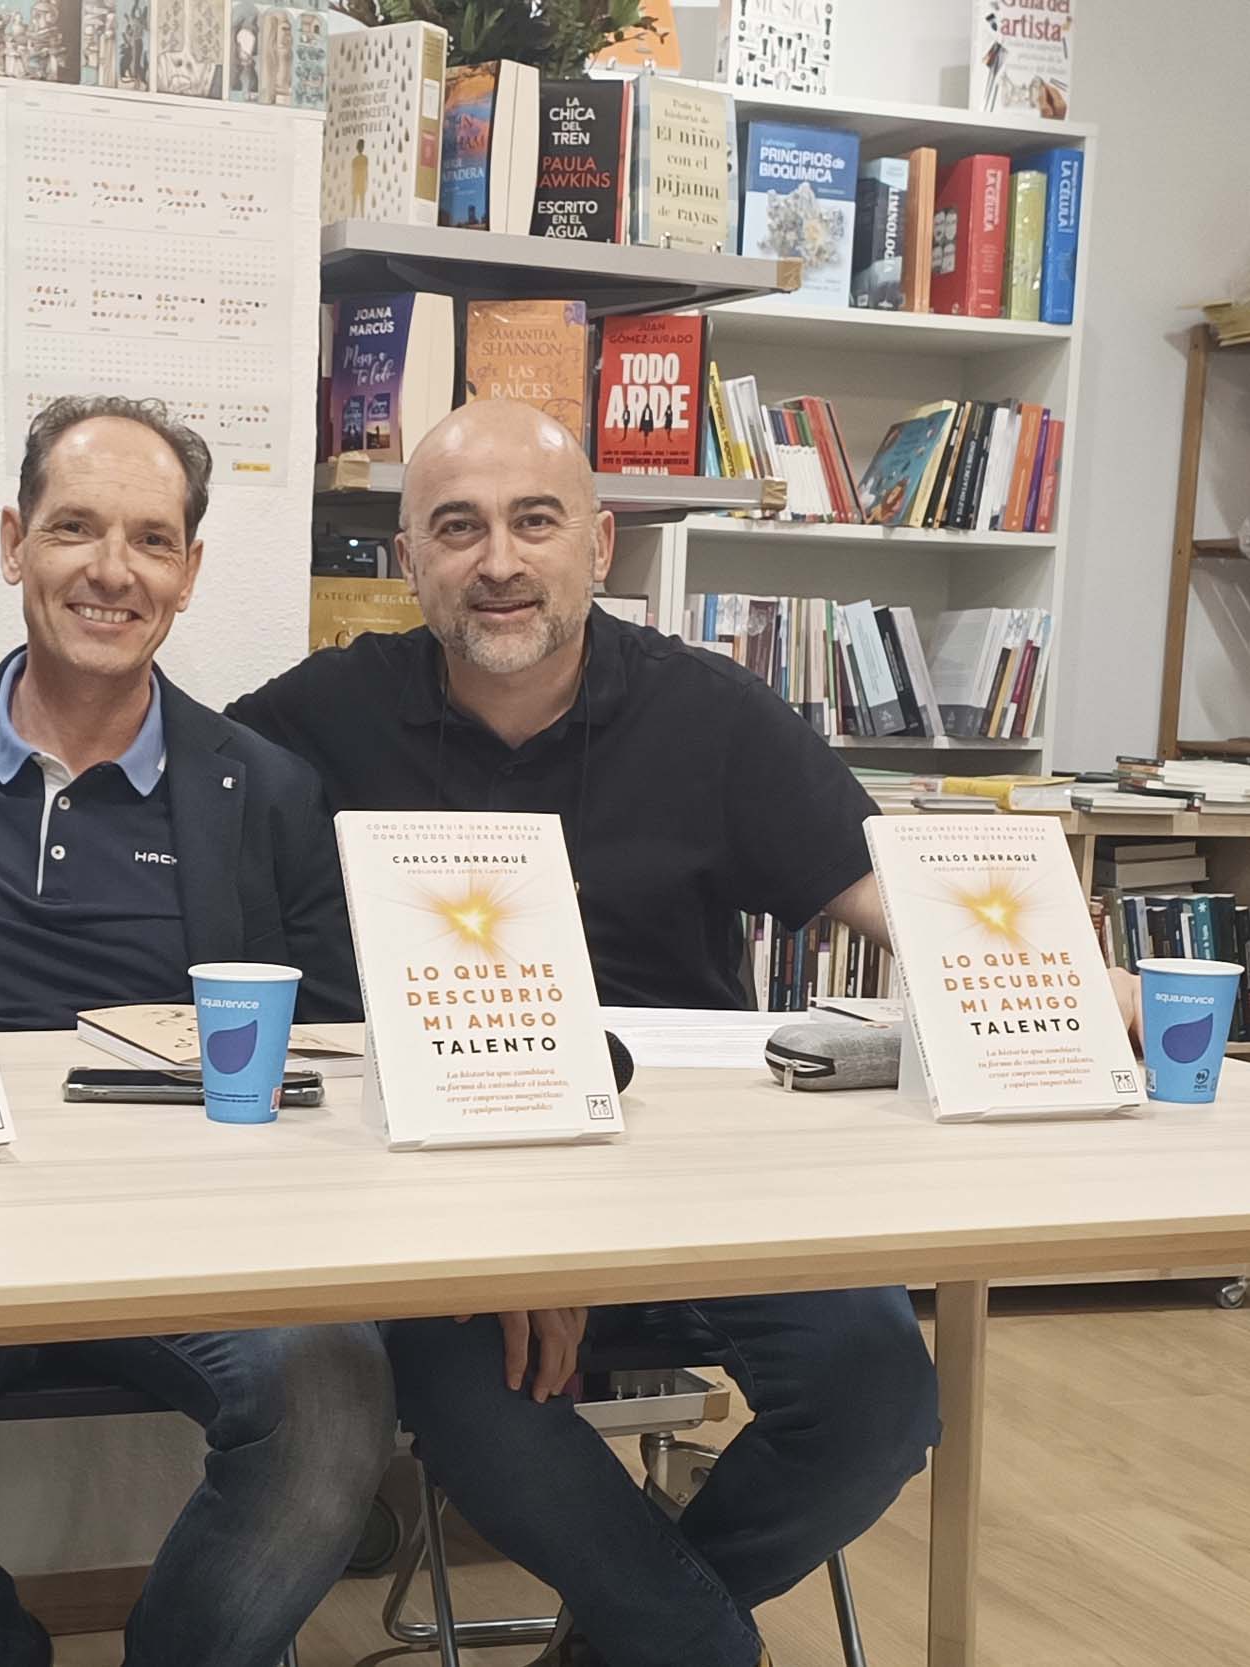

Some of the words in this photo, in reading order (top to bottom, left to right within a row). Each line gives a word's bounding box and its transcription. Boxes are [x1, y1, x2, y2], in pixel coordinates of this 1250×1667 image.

[1001, 14, 1062, 42] artista
[566, 97, 580, 107] LA
[549, 108, 595, 121] CHICA
[561, 121, 582, 131] DEL
[552, 132, 590, 145] TREN
[656, 125, 675, 142] El
[679, 127, 720, 150] niño
[542, 155, 597, 171] PAULA
[667, 155, 691, 167] con
[695, 156, 708, 170] el
[760, 146, 832, 169] PRINCIPIOS
[832, 158, 846, 170] de
[759, 162, 833, 184] BIOQUÍMICA
[1060, 161, 1072, 177] LA
[539, 172, 611, 189] AWKINS
[656, 174, 720, 200] pijama
[537, 200, 598, 214] ESCRITO
[1058, 179, 1071, 228] CÉLULA
[552, 215, 568, 225] EN
[569, 215, 582, 225] EL
[658, 204, 671, 217] de
[677, 209, 719, 227] rayas
[545, 225, 588, 239] AGUA
[354, 306, 392, 321] JOANA
[350, 319, 394, 336] MARCÚS
[487, 328, 557, 340] SAMANTHA
[638, 322, 666, 332] JUAN
[481, 342, 563, 357] SHANNON
[508, 364, 535, 379] LAS
[620, 353, 680, 385] TODO
[490, 379, 552, 399] RAÍCES
[604, 385, 691, 430] ARDE
[316, 591, 367, 602] ESTUCHE
[392, 855, 448, 864] CARLOS
[454, 853, 528, 864] BARRAQUÉ
[919, 854, 968, 862] CARLOS
[974, 853, 1038, 862] BARRAQUÉ
[942, 954, 971, 968] LO
[984, 953, 1030, 967] QUE
[1041, 952, 1072, 966] ME
[406, 966, 439, 982] LO
[454, 964, 507, 980] QUE
[520, 963, 555, 978] ME
[944, 970, 1081, 991] DESCUBRIÓ
[406, 984, 563, 1007] DESCUBRIÓ
[960, 999, 988, 1014] MI
[1000, 996, 1078, 1012] AMIGO
[423, 1015, 453, 1031] MI
[468, 1012, 557, 1029] AMIGO
[970, 1018, 1080, 1036] TALENTO
[432, 1037, 557, 1055] TALENTO
